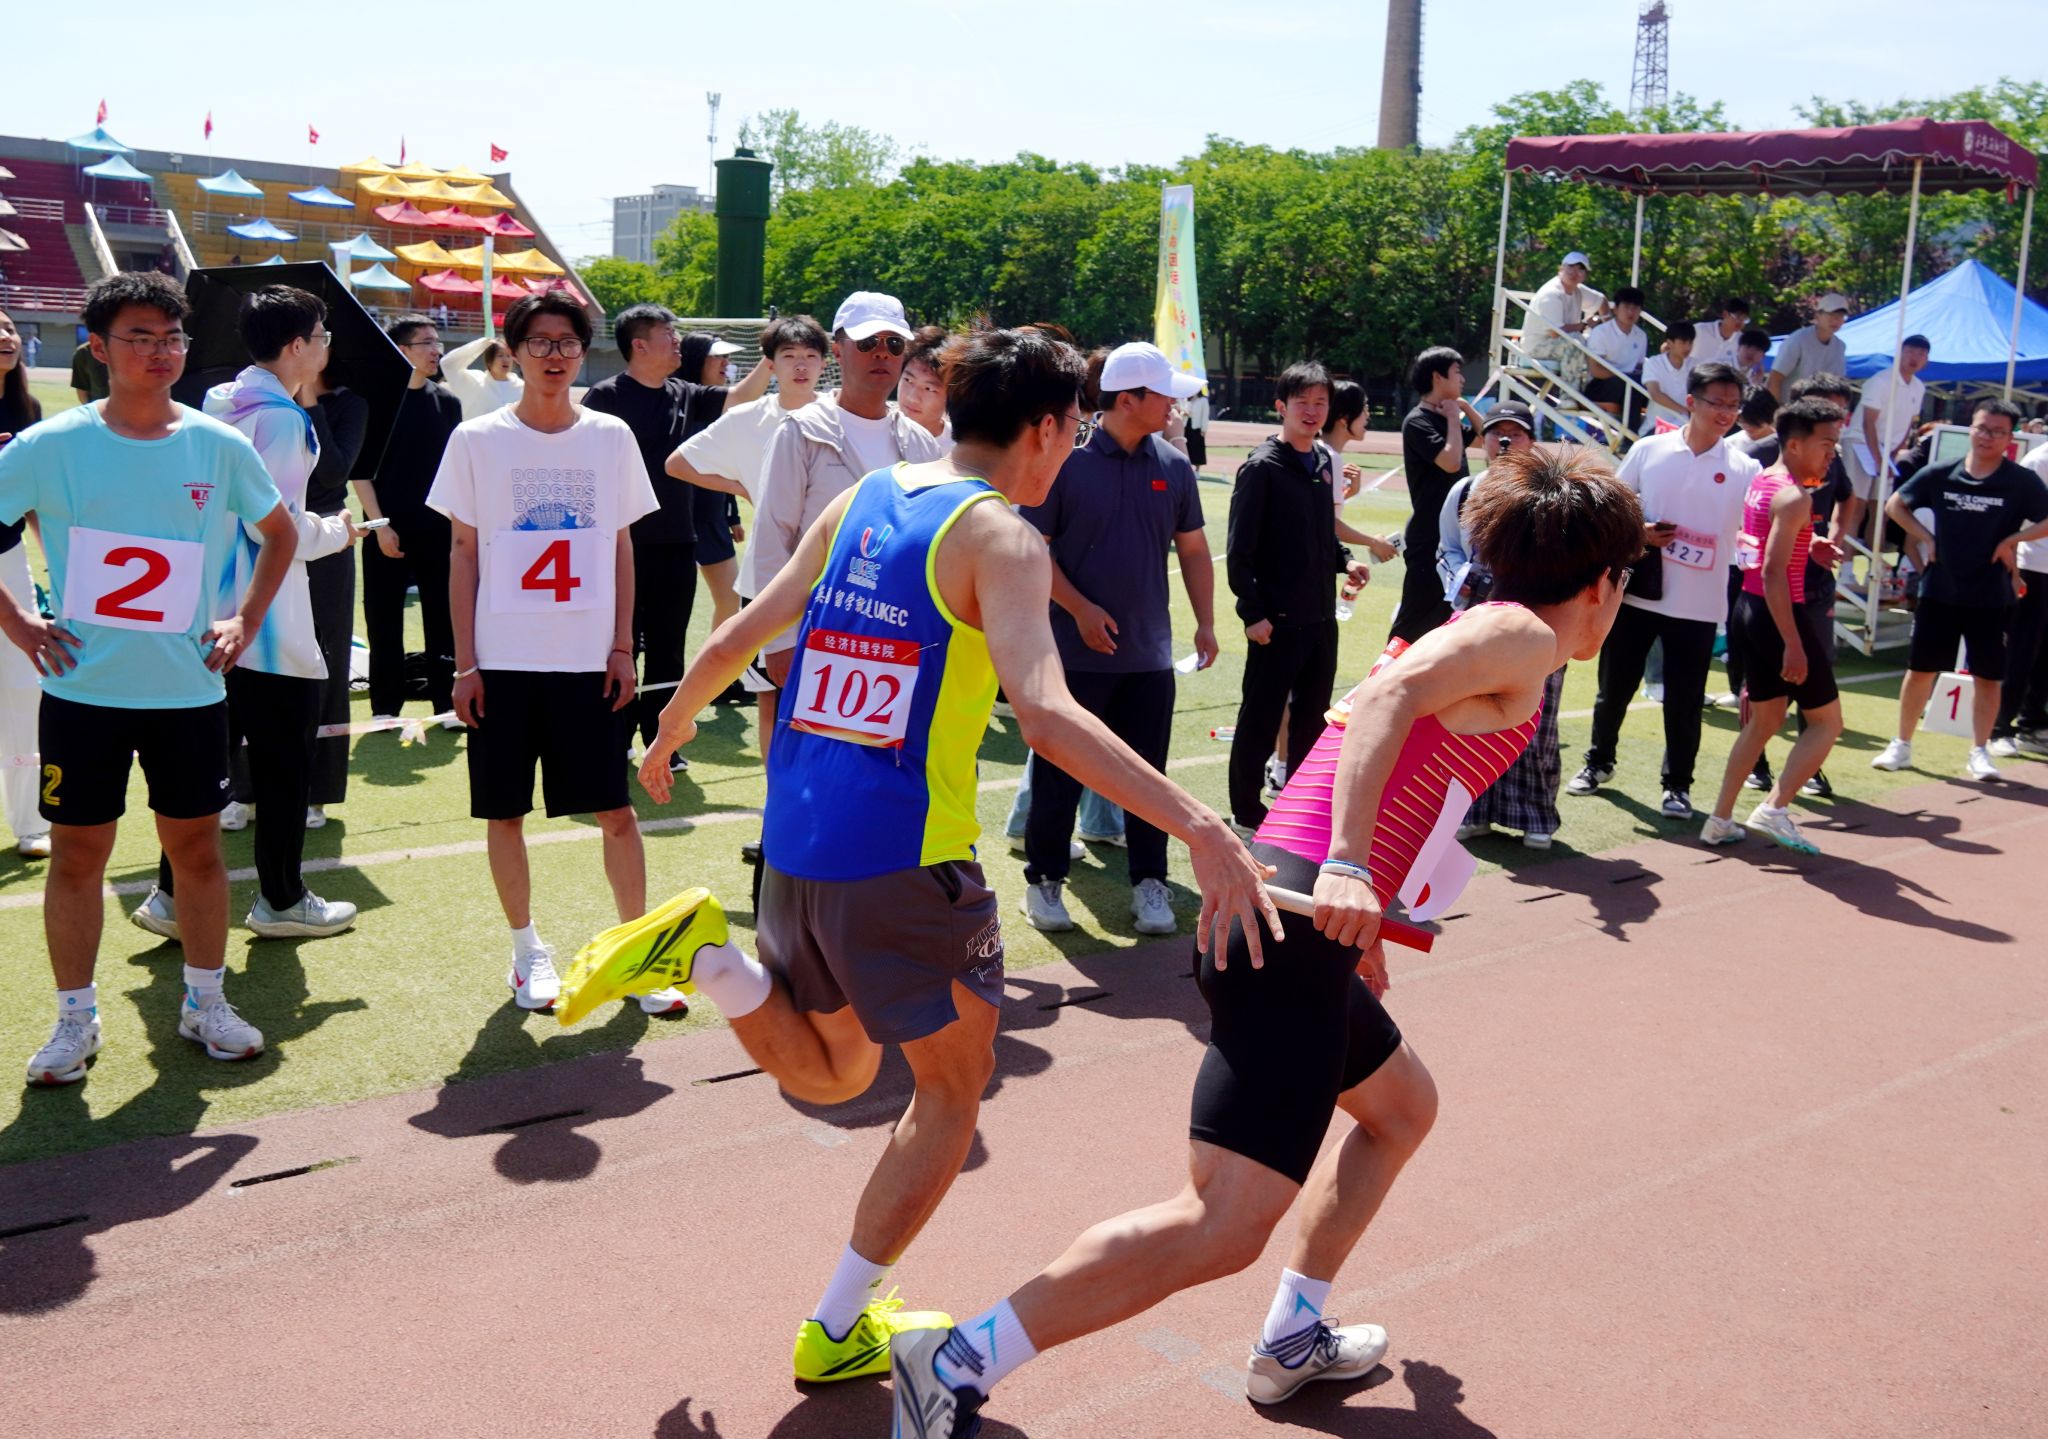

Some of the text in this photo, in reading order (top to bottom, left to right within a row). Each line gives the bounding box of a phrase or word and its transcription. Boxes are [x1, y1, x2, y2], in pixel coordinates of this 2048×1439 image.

[511, 468, 595, 483] DODGERS
[513, 484, 595, 499] DODGERS
[514, 499, 595, 513] DODGERS
[1666, 541, 1703, 563] 427
[95, 546, 170, 622] 2
[521, 540, 581, 602] 4
[807, 664, 902, 725] 102
[1947, 685, 1961, 720] 1
[43, 764, 62, 806] 2
